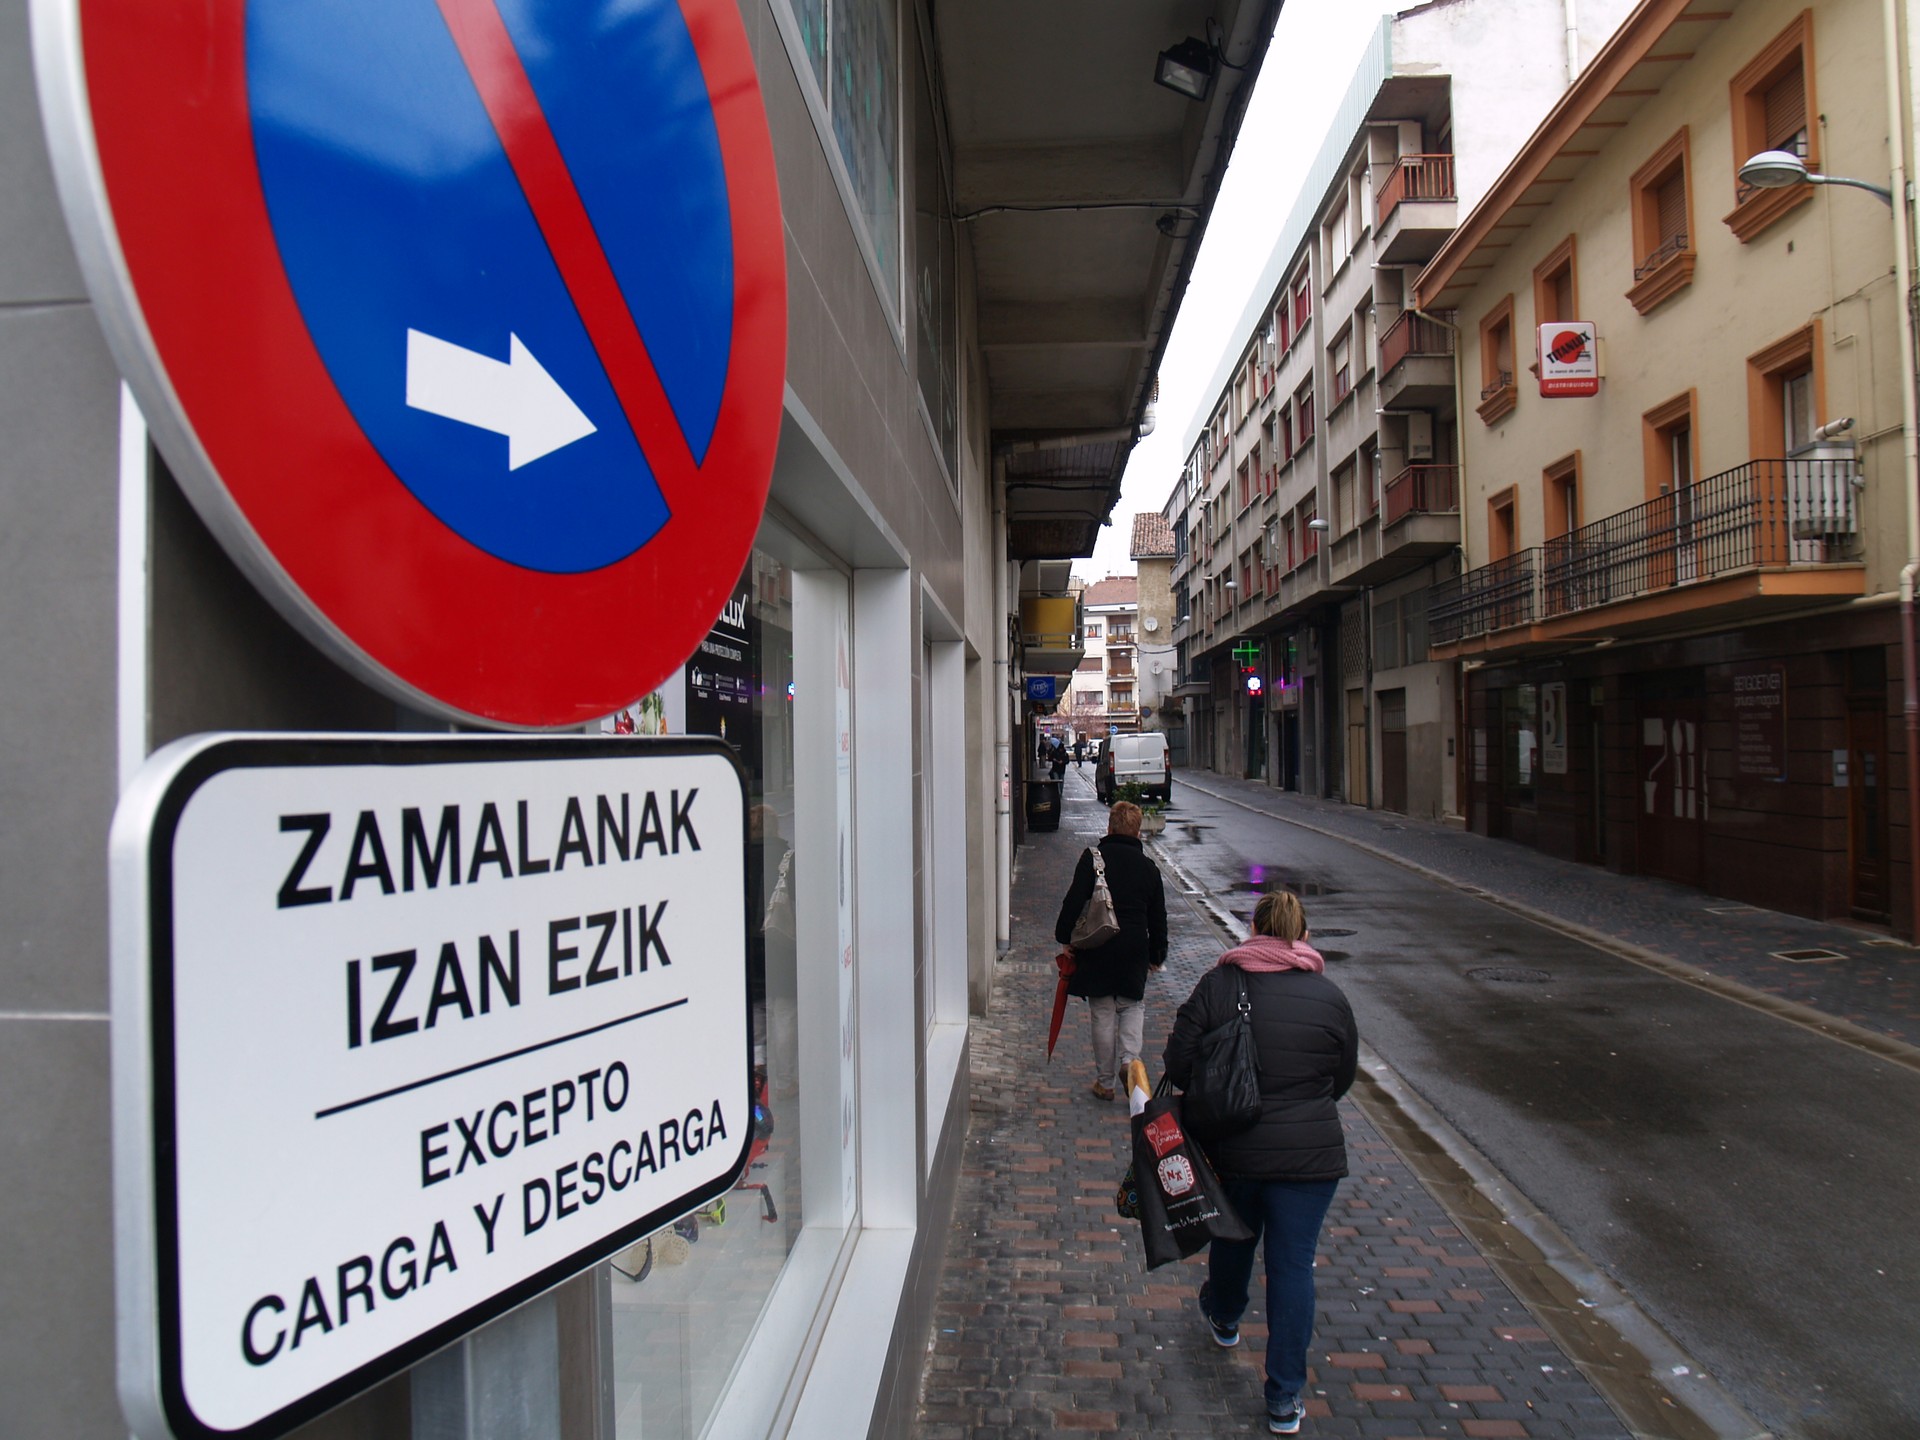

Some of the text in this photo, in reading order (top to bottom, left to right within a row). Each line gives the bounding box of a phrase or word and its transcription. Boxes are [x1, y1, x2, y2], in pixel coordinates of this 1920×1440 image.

[1546, 330, 1591, 363] TITANLUX
[1548, 381, 1594, 389] DISTRIBUIDOR
[278, 789, 700, 909] ZAMALANAK
[348, 901, 671, 1048] IZAN EZIK
[421, 1061, 628, 1187] EXCEPTO
[242, 1100, 726, 1366] CARGA Y DESCARGA
